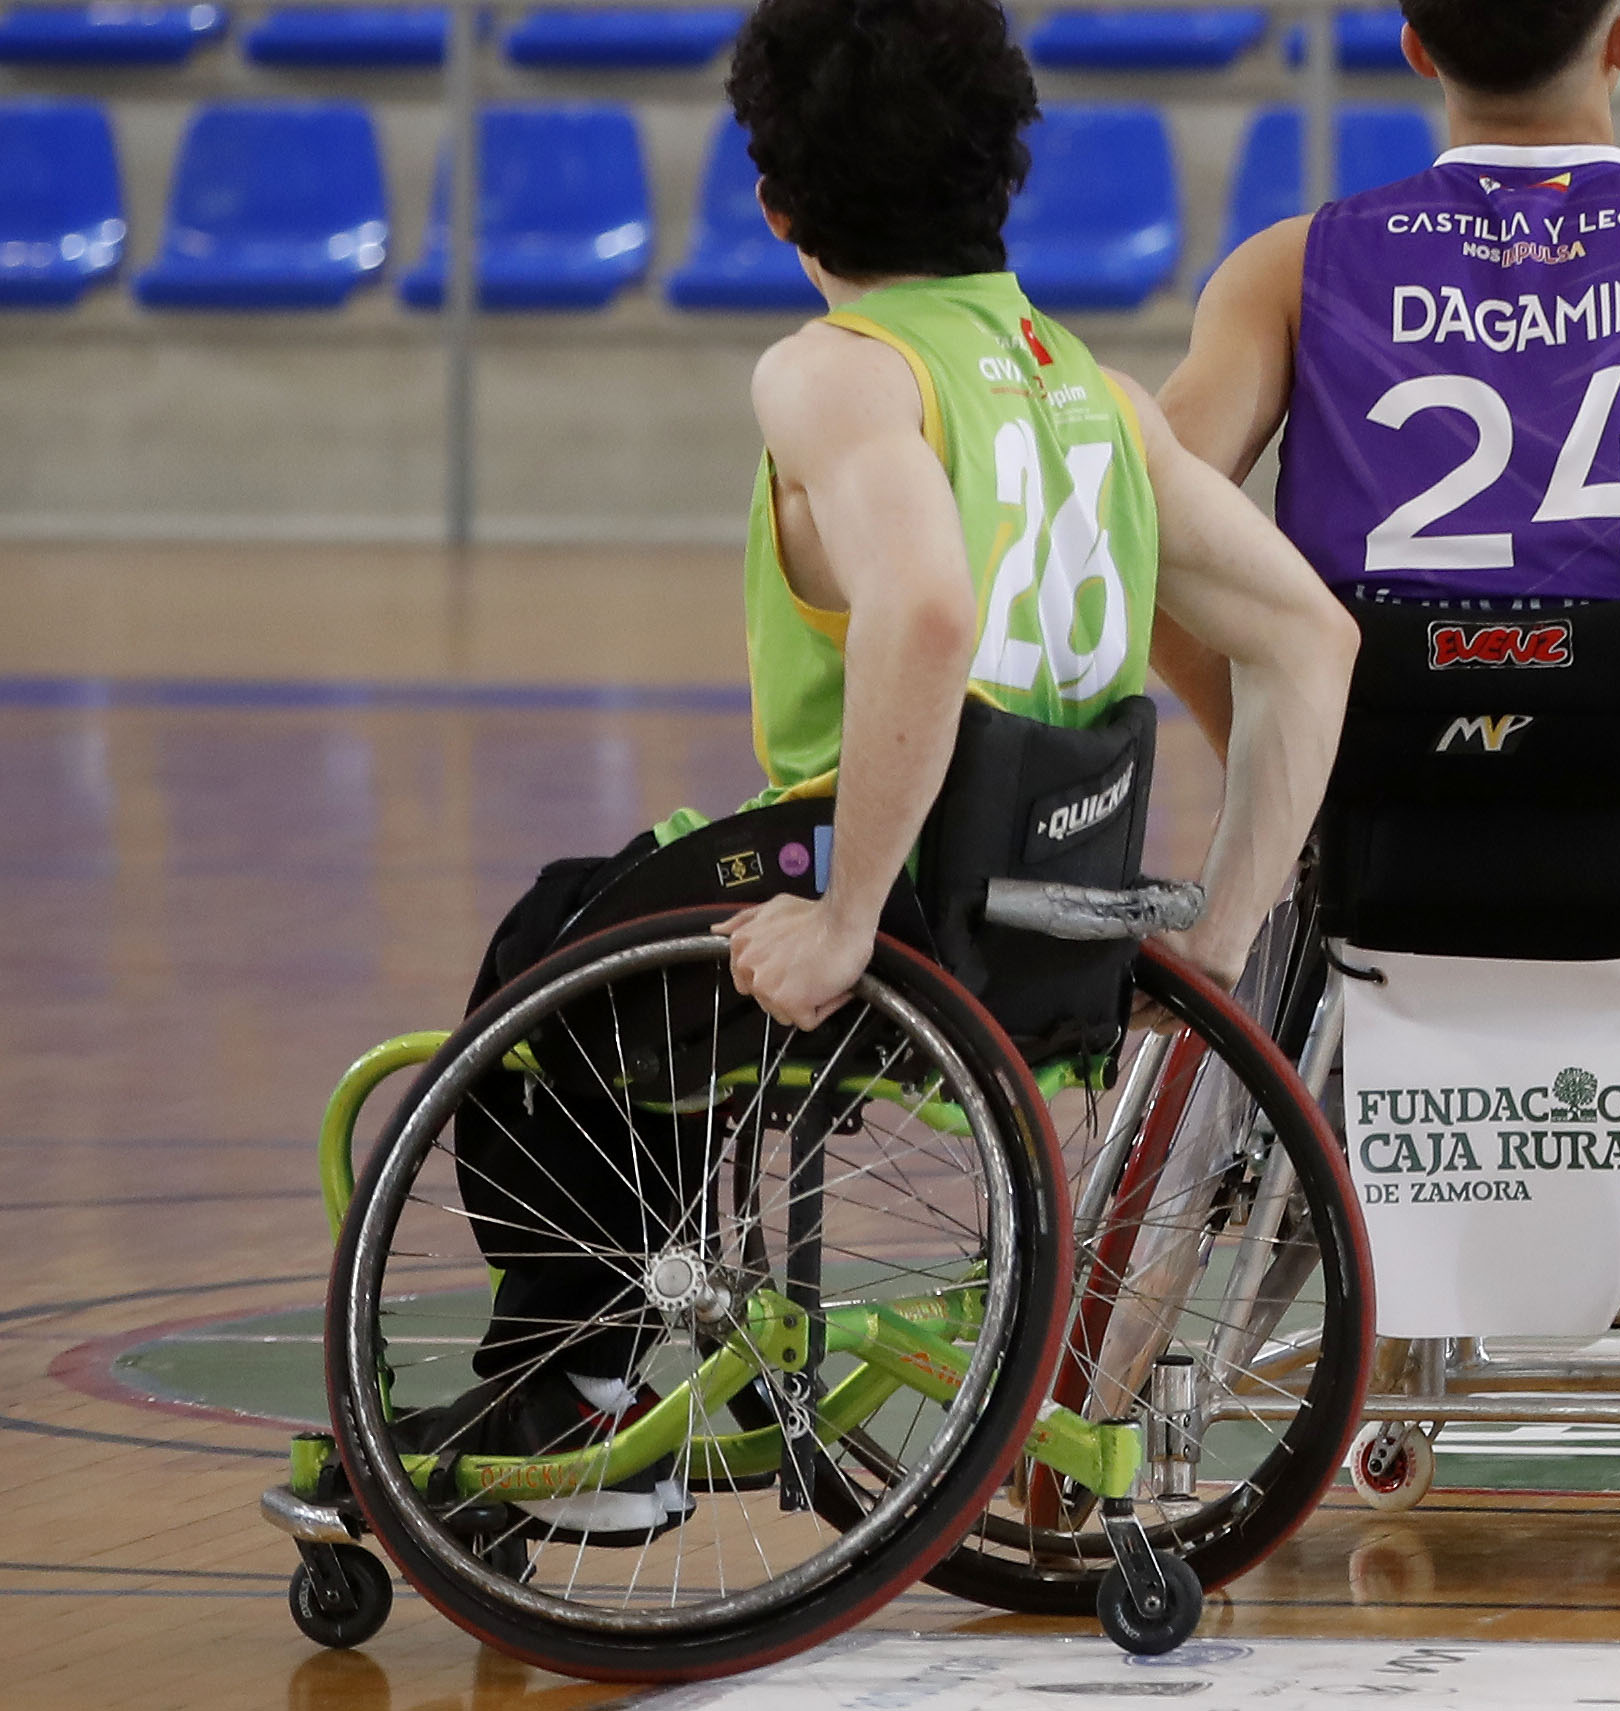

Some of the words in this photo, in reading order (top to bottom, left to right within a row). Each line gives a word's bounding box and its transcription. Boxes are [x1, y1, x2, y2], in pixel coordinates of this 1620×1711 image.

[1387, 210, 1531, 242] CASTILLA
[1543, 216, 1565, 245] Y
[969, 417, 1127, 701] 26
[1435, 714, 1534, 753] MVP
[1359, 1133, 1482, 1177] CAJA
[1365, 1183, 1399, 1205] DE
[1410, 1180, 1533, 1204] ZAMORA
